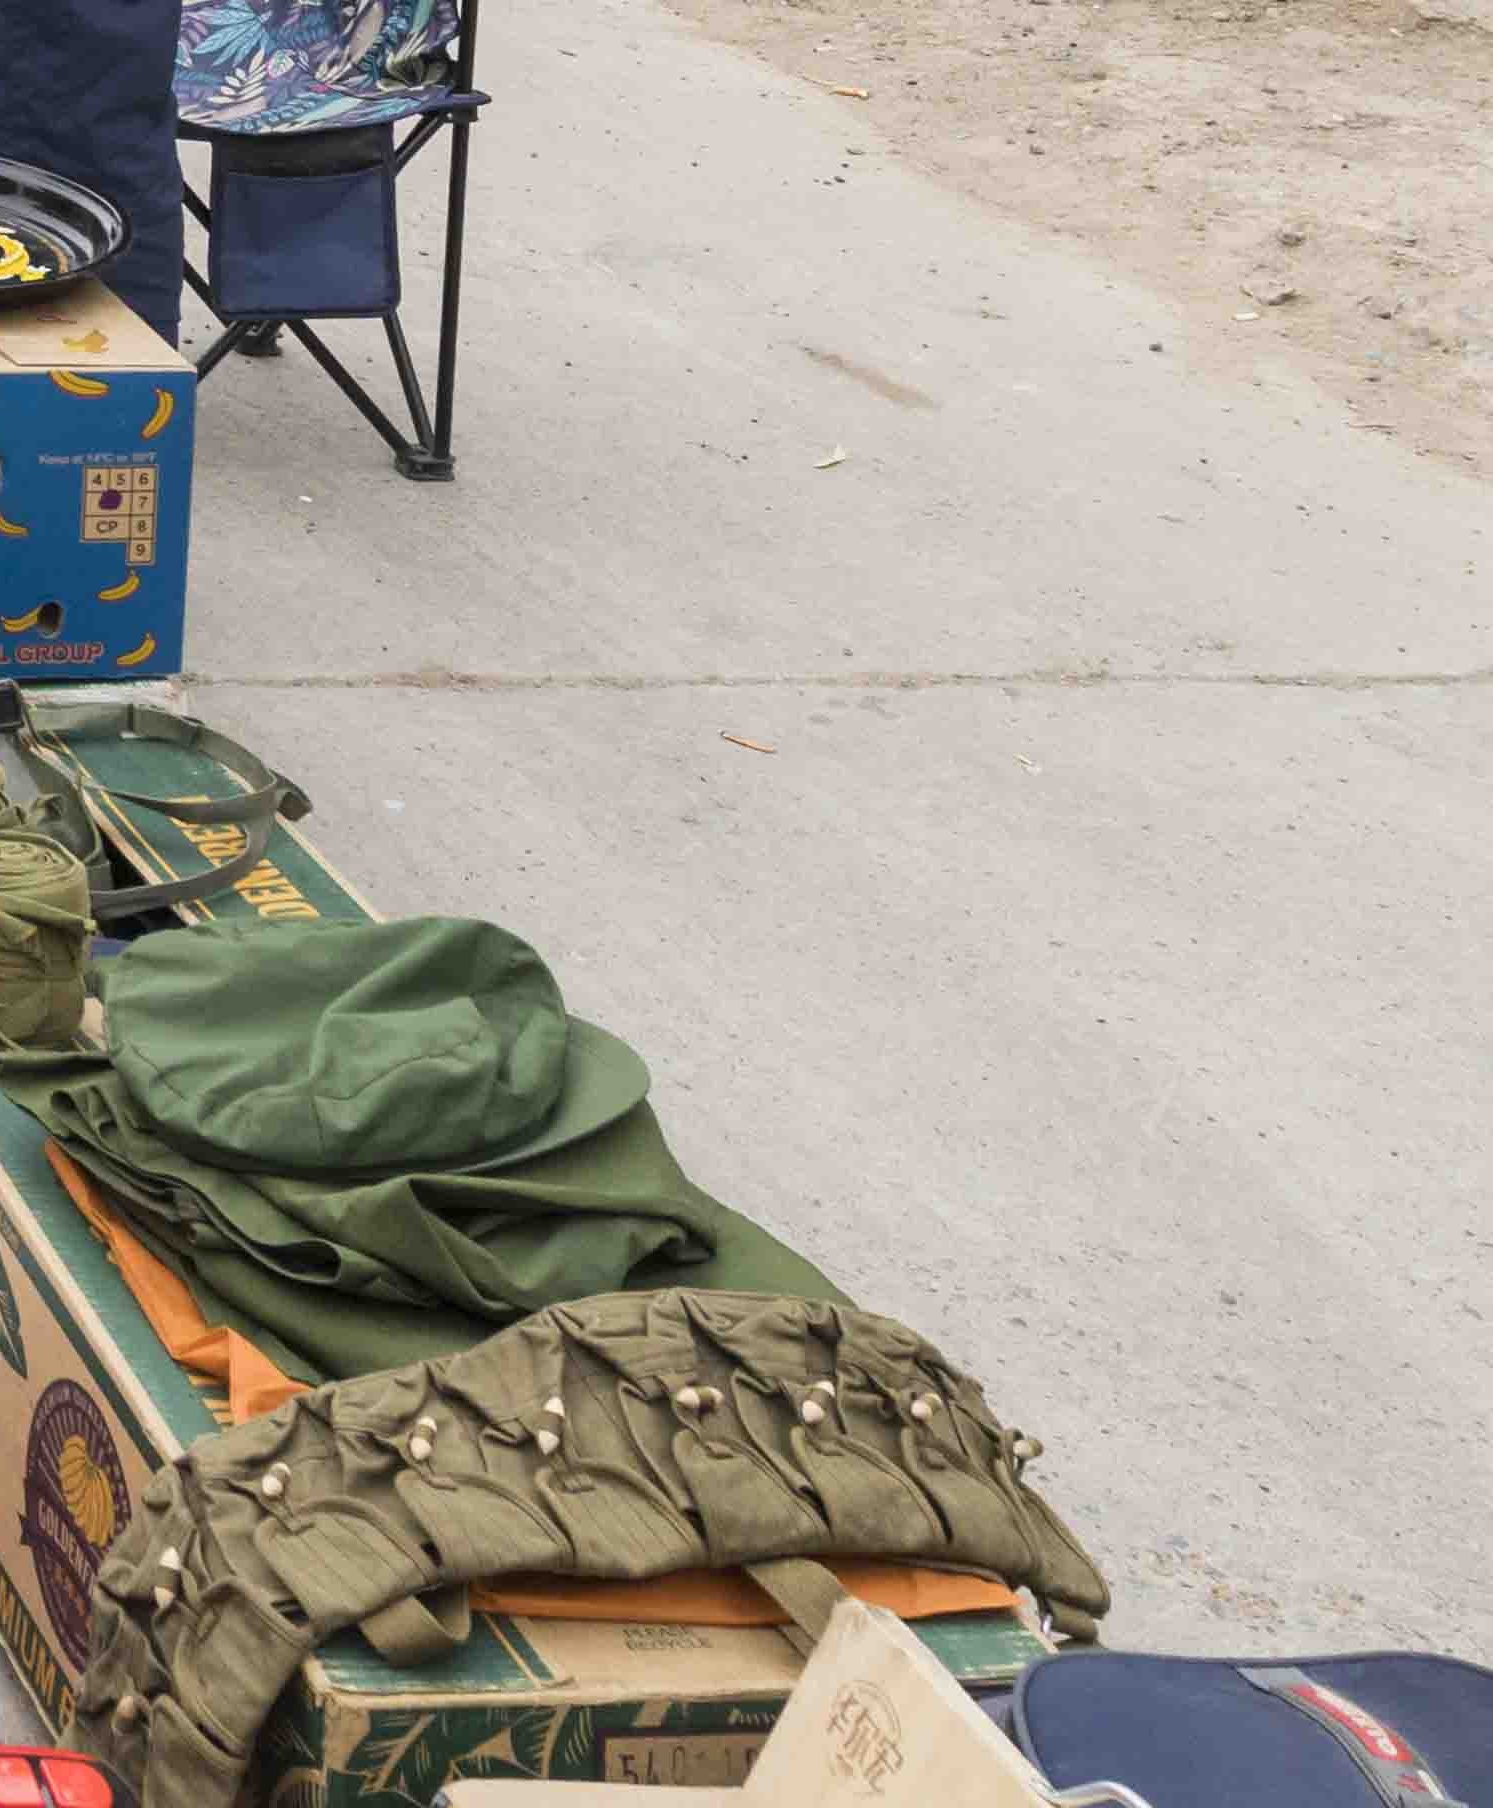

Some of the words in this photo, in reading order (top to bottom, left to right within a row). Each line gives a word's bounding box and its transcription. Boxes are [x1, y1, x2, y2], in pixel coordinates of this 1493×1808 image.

[91, 473, 103, 486] 4
[116, 473, 126, 485] 5
[138, 472, 149, 485] 6
[137, 496, 148, 508] 7
[95, 520, 118, 534] CP
[137, 520, 147, 533] 8
[135, 543, 146, 556] 9
[15, 642, 104, 666] GROUP
